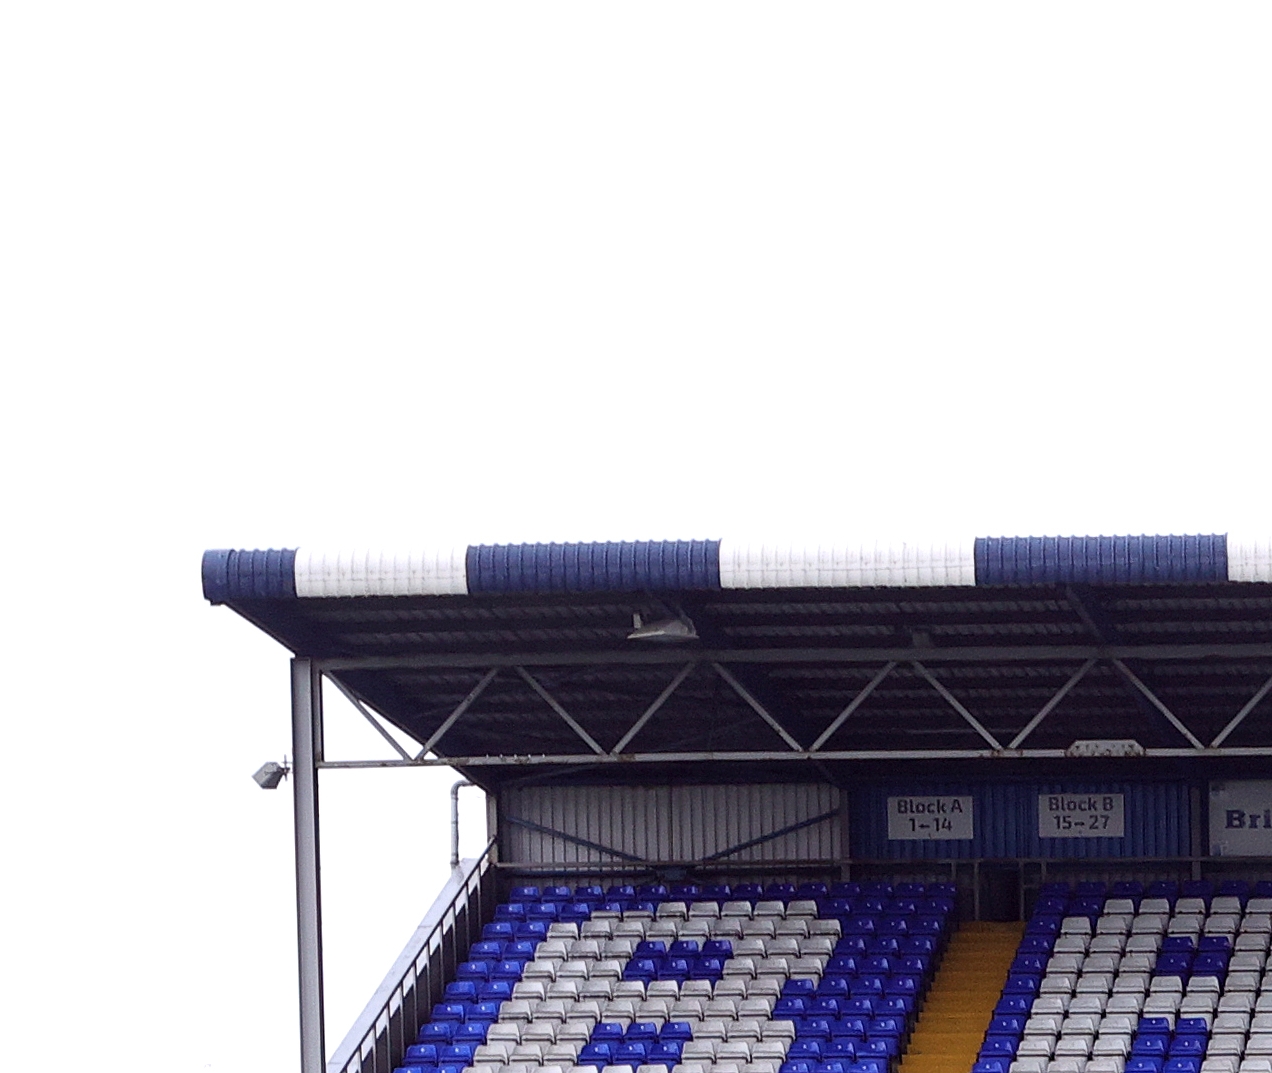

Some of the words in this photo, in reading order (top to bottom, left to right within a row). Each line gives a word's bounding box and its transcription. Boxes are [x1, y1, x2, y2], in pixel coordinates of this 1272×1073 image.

[897, 799, 948, 814] Block
[951, 799, 963, 813] A
[1048, 796, 1097, 812] Block
[1103, 796, 1114, 811] B
